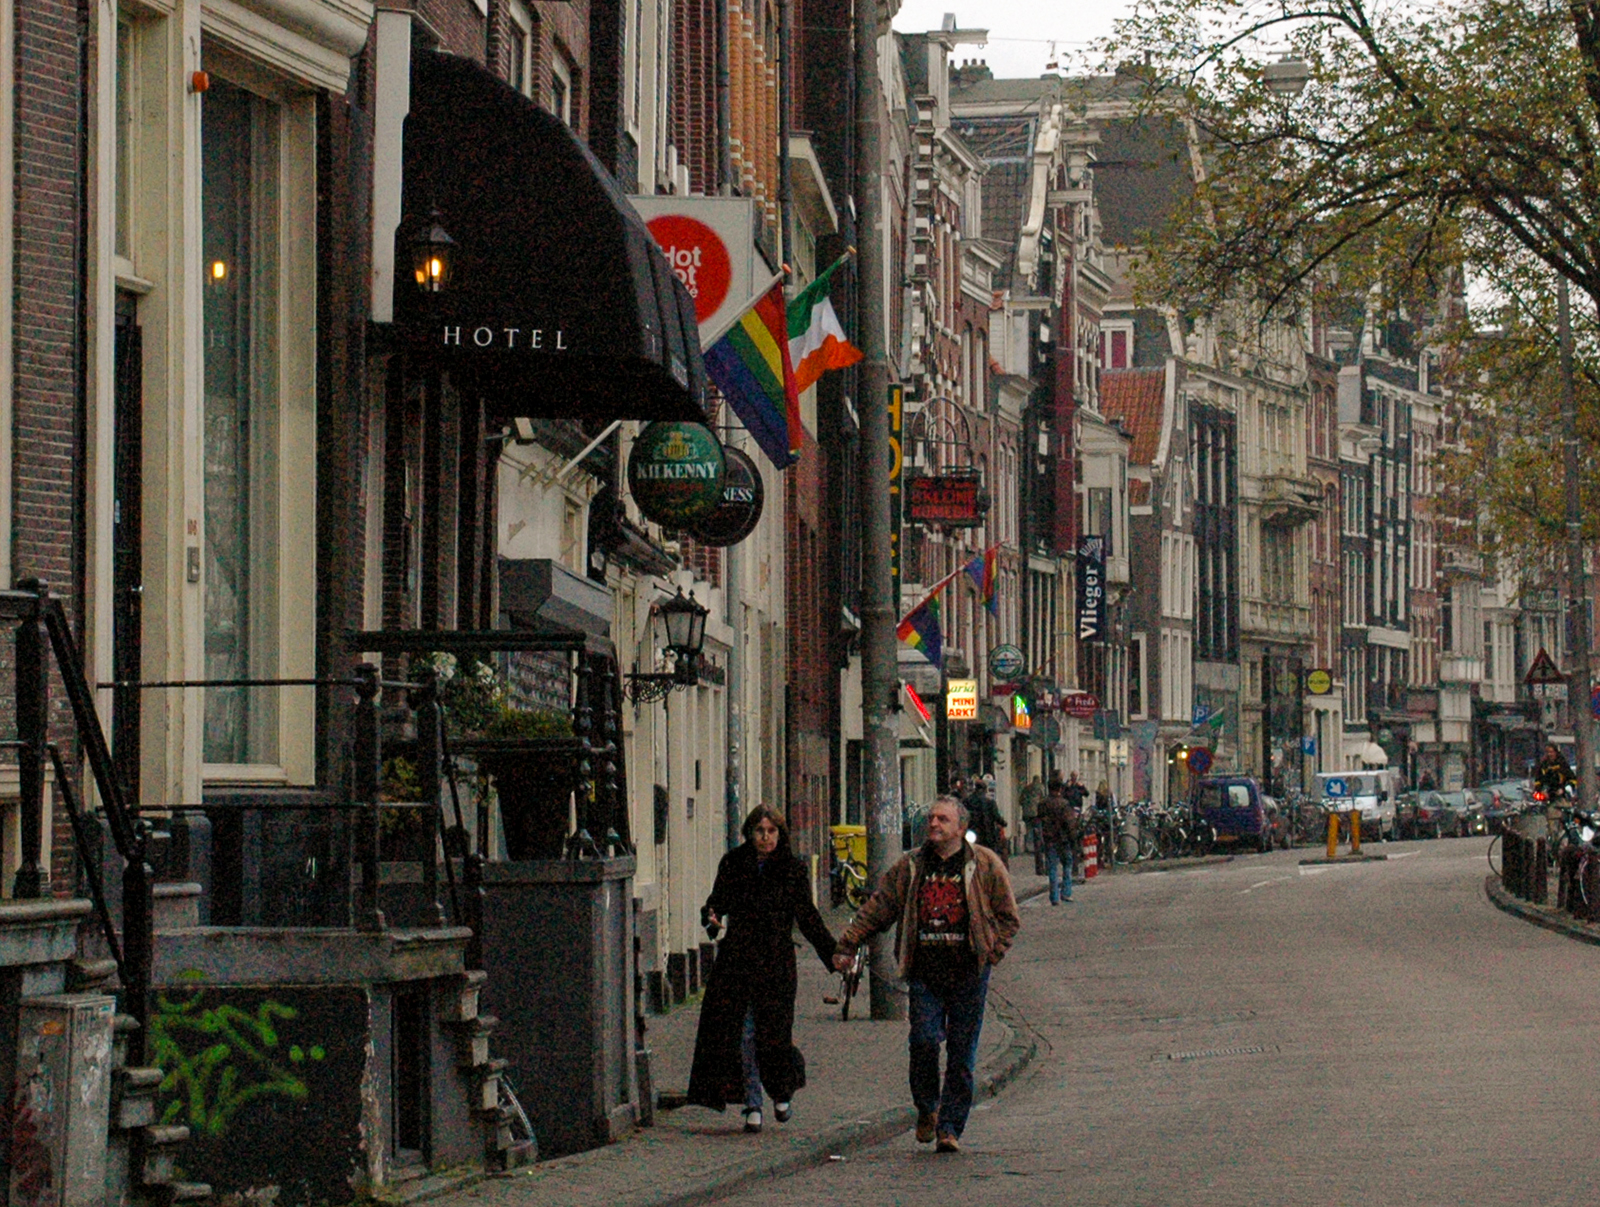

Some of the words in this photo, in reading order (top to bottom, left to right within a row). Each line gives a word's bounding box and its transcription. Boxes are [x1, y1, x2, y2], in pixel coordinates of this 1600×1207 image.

[659, 245, 702, 268] Hot
[674, 265, 697, 285] ot
[443, 325, 568, 350] HOTEL
[636, 461, 718, 479] KILKENNY
[723, 486, 753, 503] NESS
[1080, 565, 1102, 640] Vlieger
[950, 682, 975, 693] aria
[952, 697, 975, 706] MINI
[948, 708, 976, 717] ARKT
